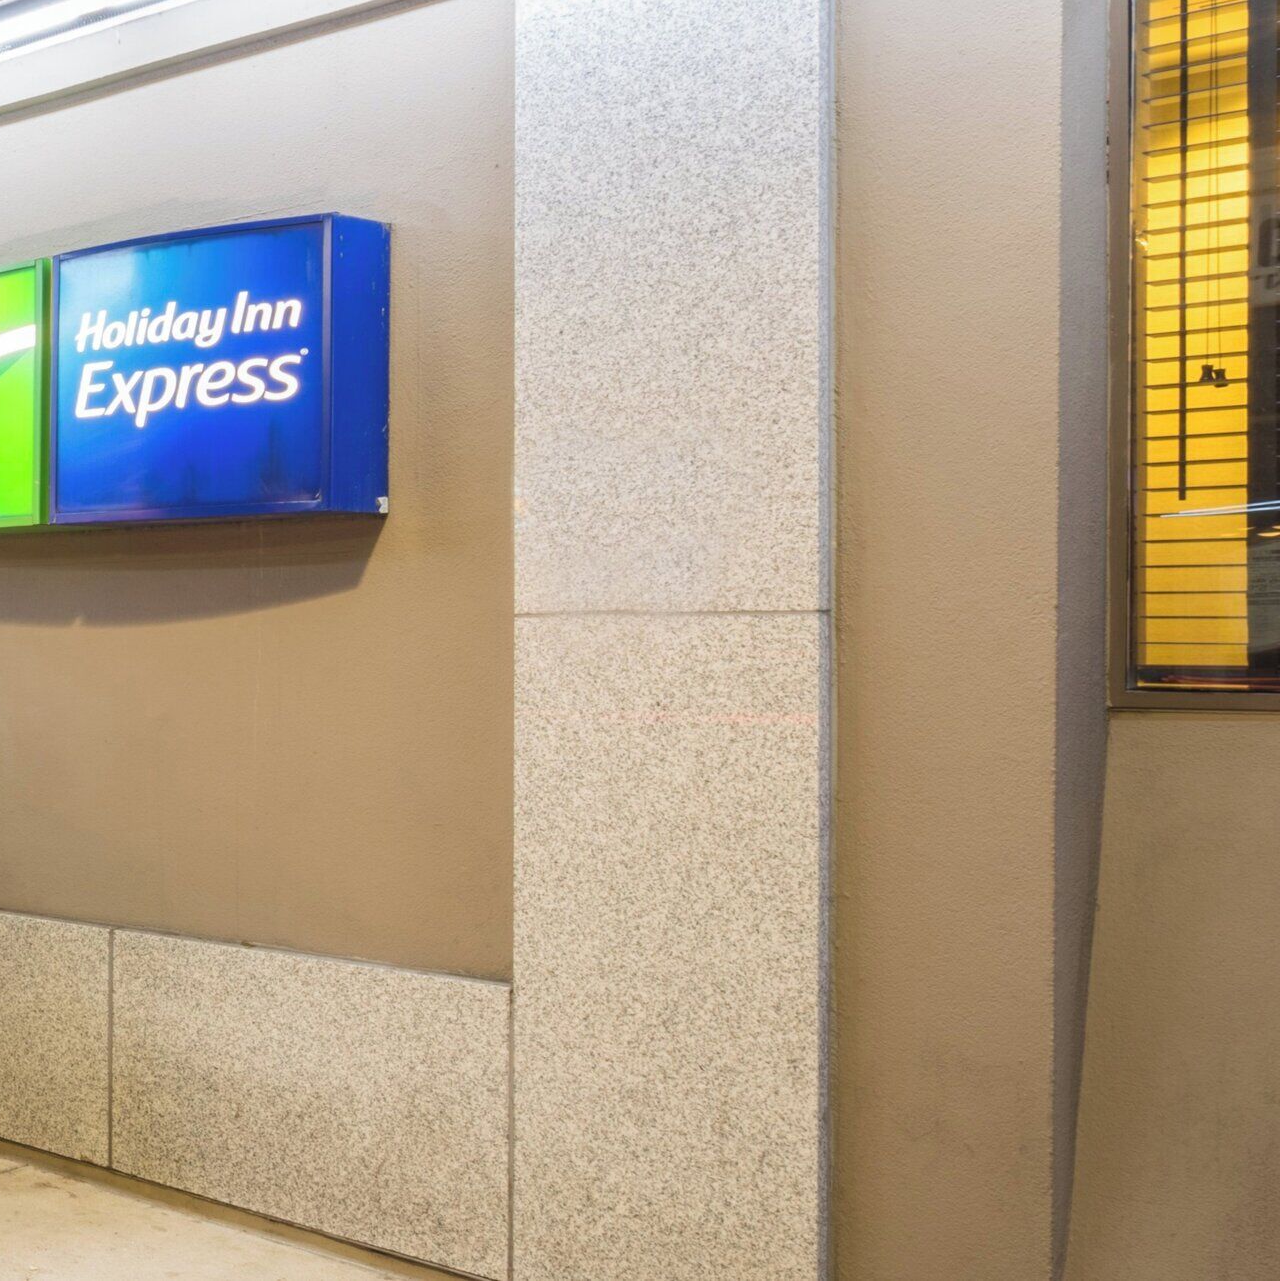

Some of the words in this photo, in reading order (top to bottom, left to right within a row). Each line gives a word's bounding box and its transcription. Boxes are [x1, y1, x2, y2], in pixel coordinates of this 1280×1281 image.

[74, 301, 227, 353] Holiday
[230, 290, 303, 335] Inn
[74, 353, 303, 429] Express
